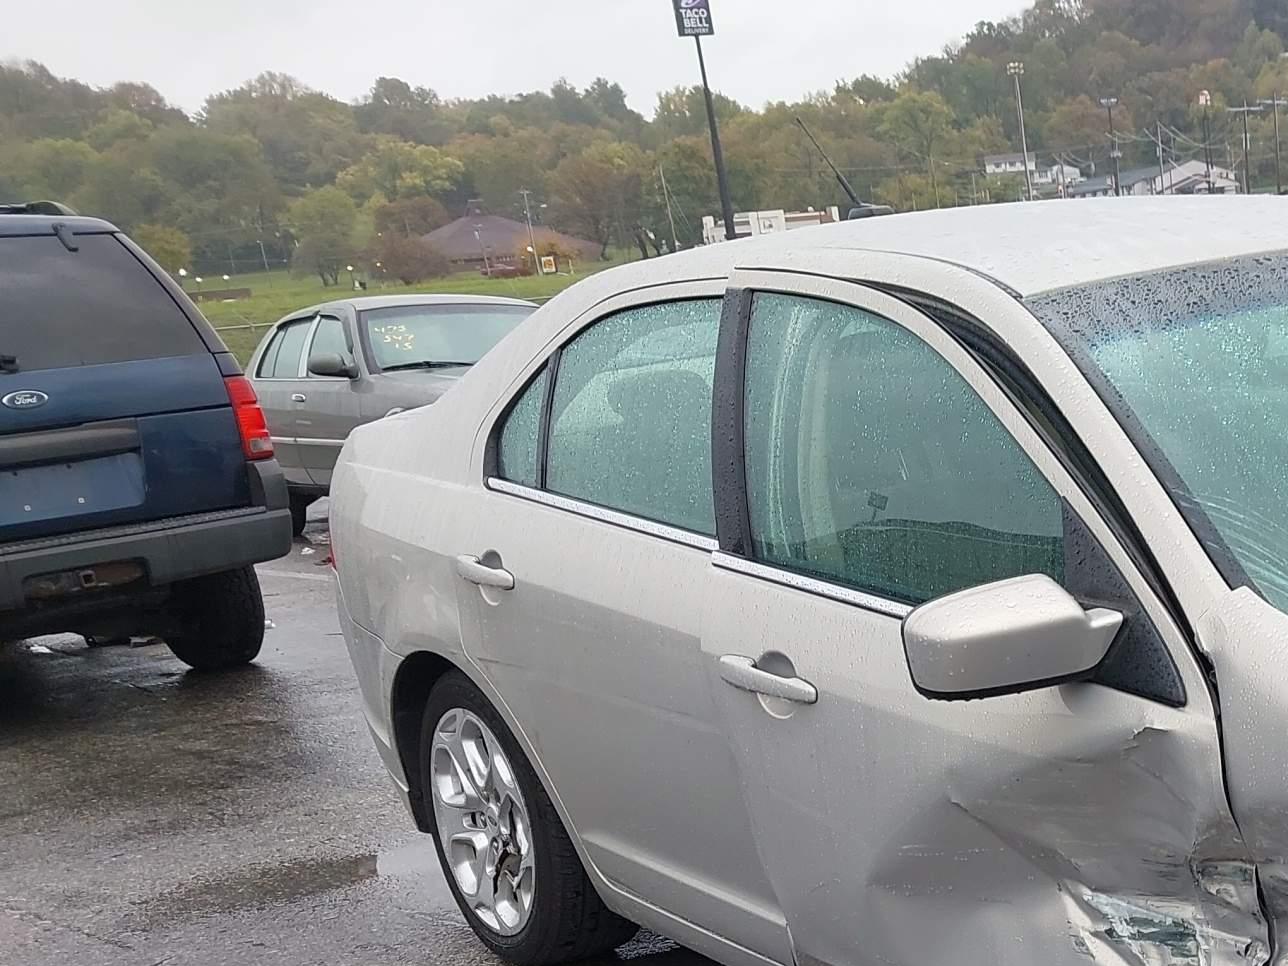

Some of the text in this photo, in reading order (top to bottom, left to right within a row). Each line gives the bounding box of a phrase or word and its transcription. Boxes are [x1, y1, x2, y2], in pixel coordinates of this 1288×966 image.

[679, 8, 708, 18] TACO
[683, 18, 709, 28] BELL
[14, 394, 37, 405] Ford
